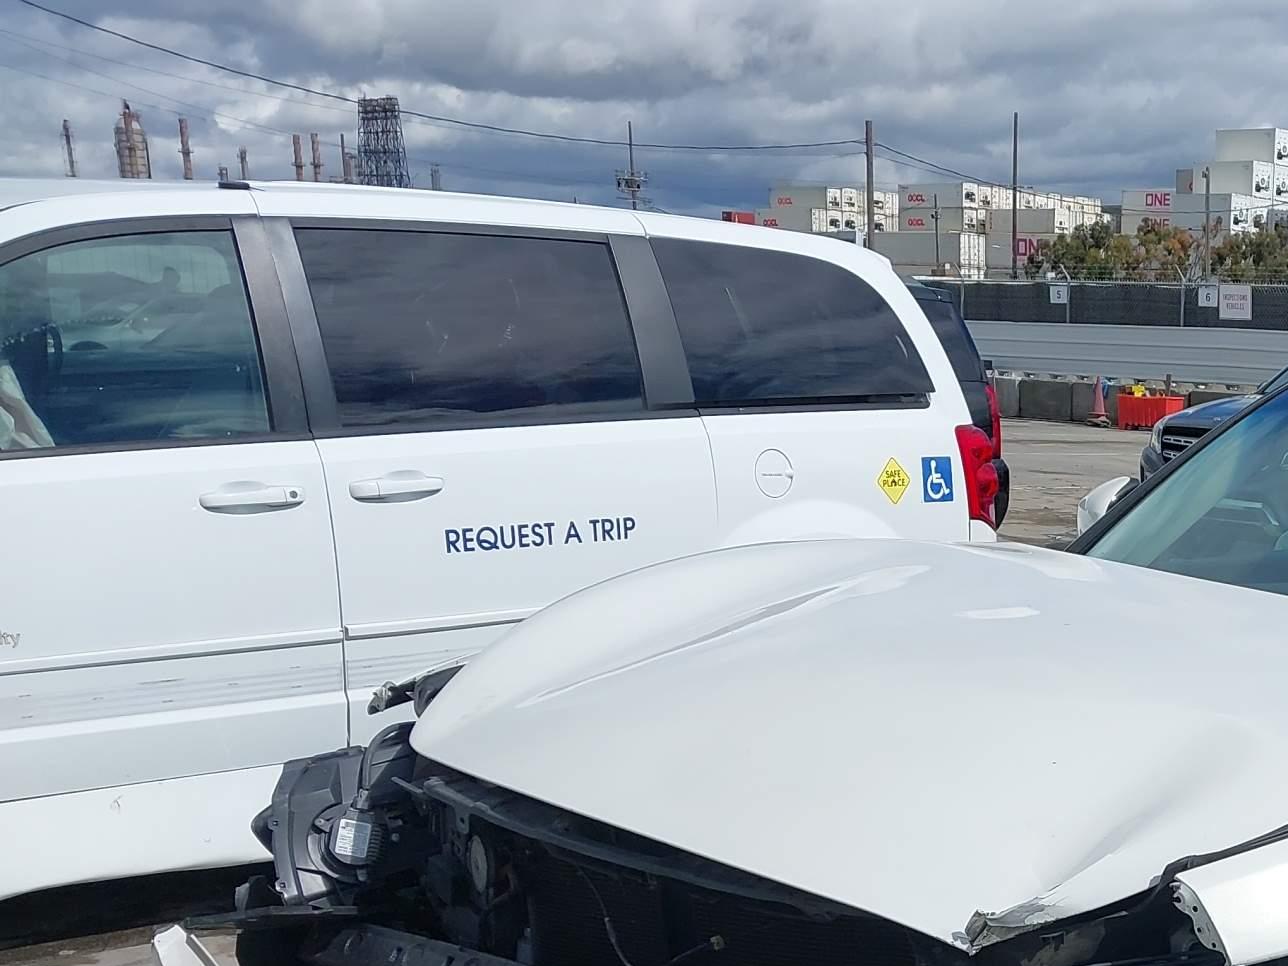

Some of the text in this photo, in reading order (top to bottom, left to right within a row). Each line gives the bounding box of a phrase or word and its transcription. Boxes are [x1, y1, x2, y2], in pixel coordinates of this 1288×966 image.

[1145, 193, 1170, 206] ONE
[1056, 290, 1062, 299] 5
[1205, 293, 1211, 302] 6
[885, 469, 901, 479] SAFE
[882, 478, 906, 488] PLACE
[444, 517, 636, 553] REQUEST A TRIP
